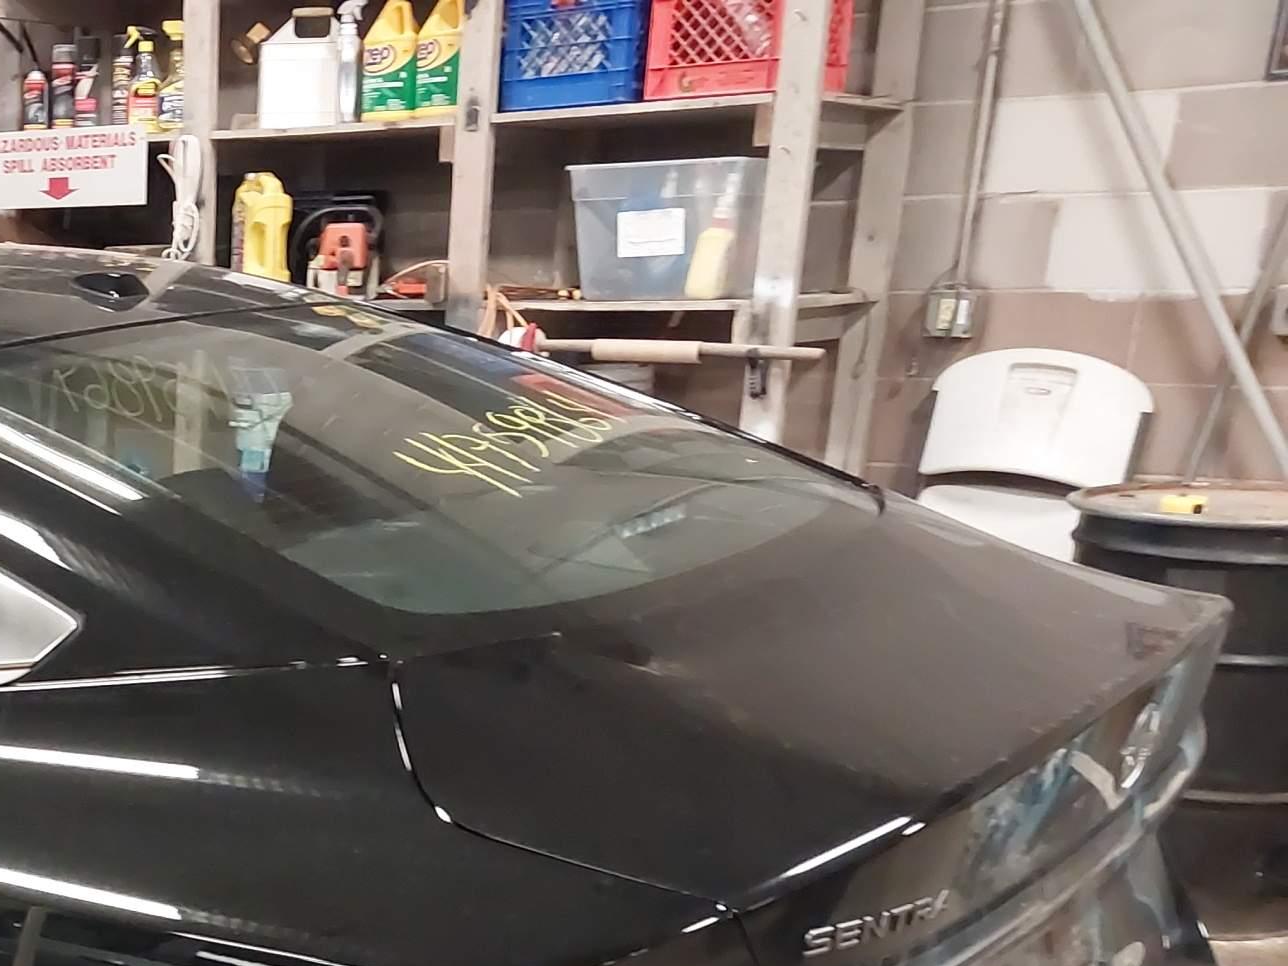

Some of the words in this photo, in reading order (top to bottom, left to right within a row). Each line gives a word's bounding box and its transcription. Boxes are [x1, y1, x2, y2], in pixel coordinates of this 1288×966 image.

[65, 131, 137, 150] MATERIALS
[3, 159, 34, 174] SPILL
[41, 154, 117, 172] ABSORBENT
[801, 888, 951, 957] SENTRA
